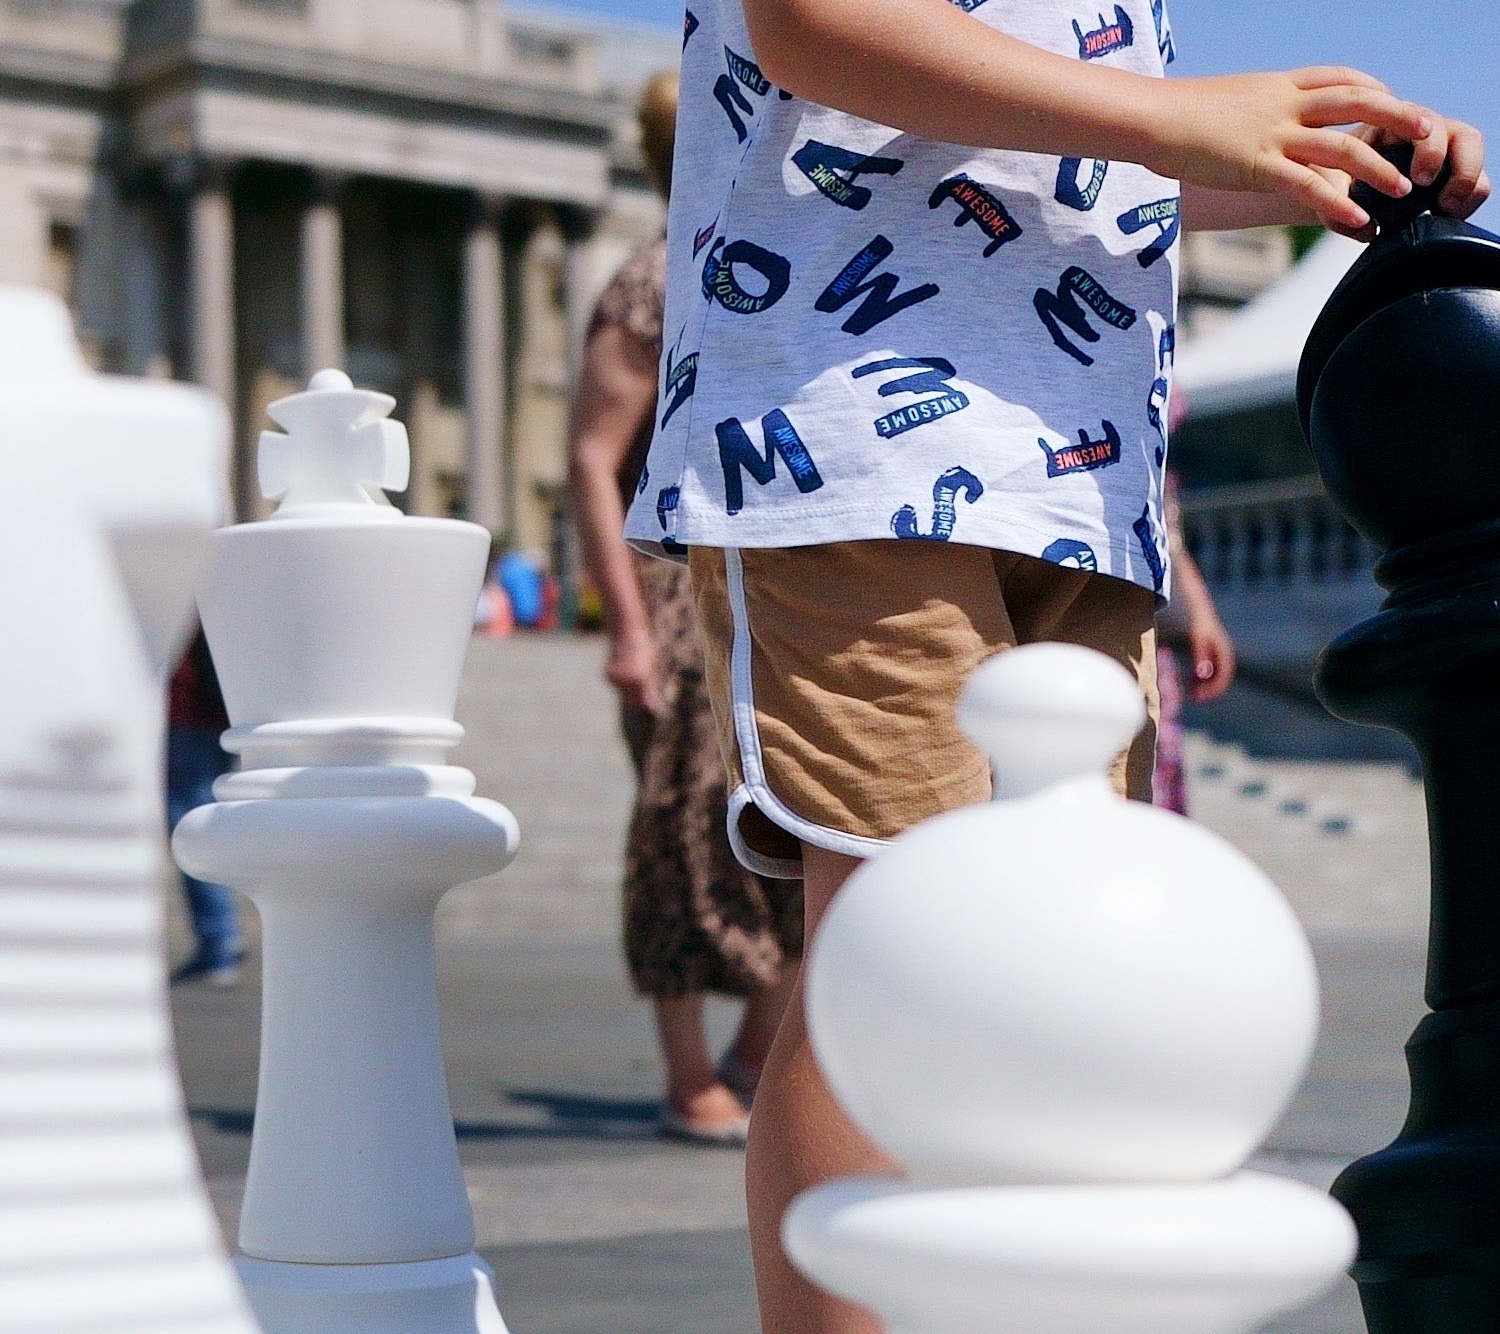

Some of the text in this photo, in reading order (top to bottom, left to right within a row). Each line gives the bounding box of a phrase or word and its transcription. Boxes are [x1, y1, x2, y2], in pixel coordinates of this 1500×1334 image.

[808, 163, 854, 202] AWESOME
[952, 182, 1010, 236] AWESOME
[1138, 199, 1178, 223] AWESOME
[711, 239, 791, 314] O
[717, 260, 765, 311] AWESOME
[814, 234, 940, 336] W
[832, 248, 880, 297] AWESOME
[1033, 266, 1137, 366] M
[1070, 271, 1130, 329] AWESOME
[877, 396, 963, 433] AWESOME
[715, 408, 824, 516] M
[773, 426, 814, 479] AWESOME
[1056, 442, 1112, 469] AWESOME
[936, 486, 953, 537] AWESOME
